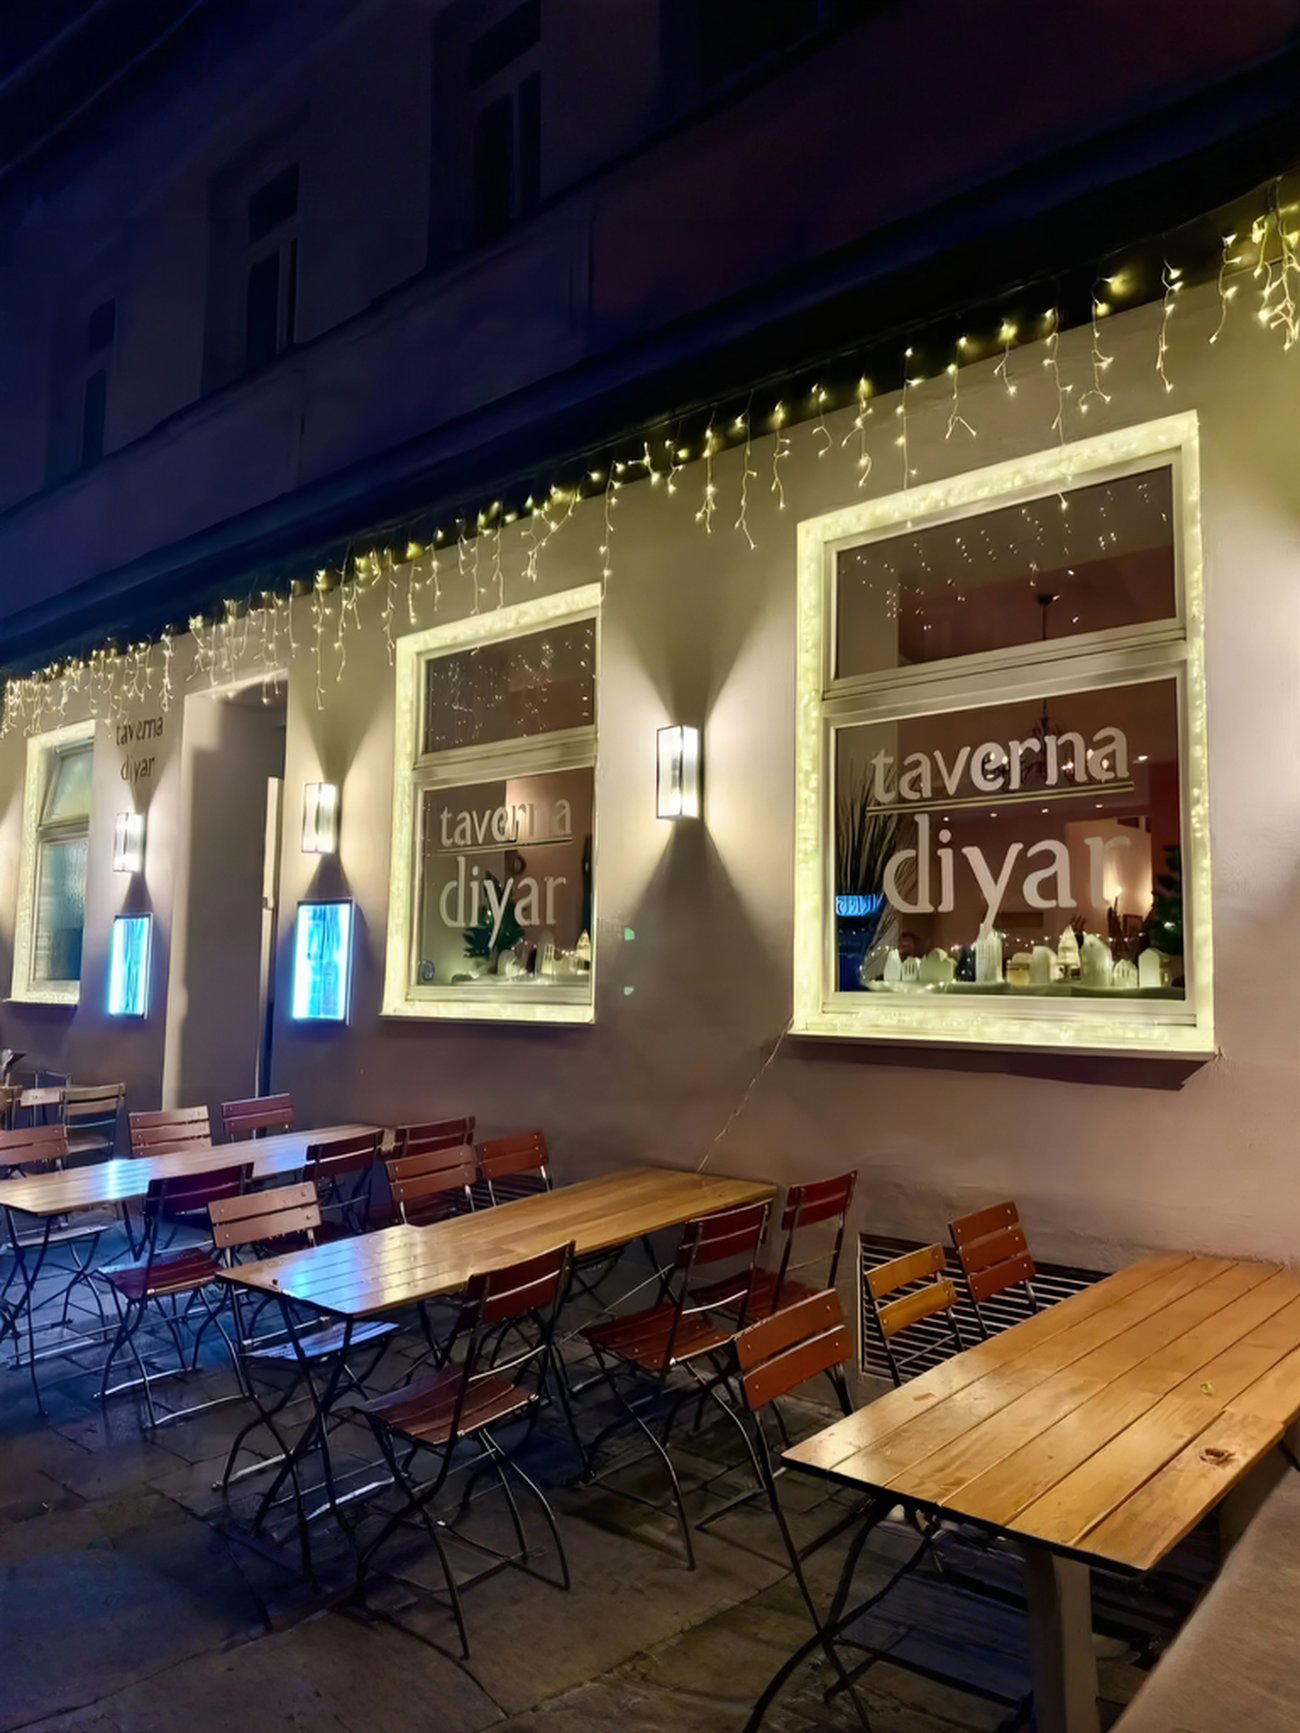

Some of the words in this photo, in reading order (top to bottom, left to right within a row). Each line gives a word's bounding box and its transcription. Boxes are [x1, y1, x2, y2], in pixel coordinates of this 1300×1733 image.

[116, 716, 163, 746] taverna
[120, 753, 155, 783] diyar
[870, 726, 1130, 802] taverna
[439, 855, 567, 947] diyar
[881, 813, 1132, 939] diyar
